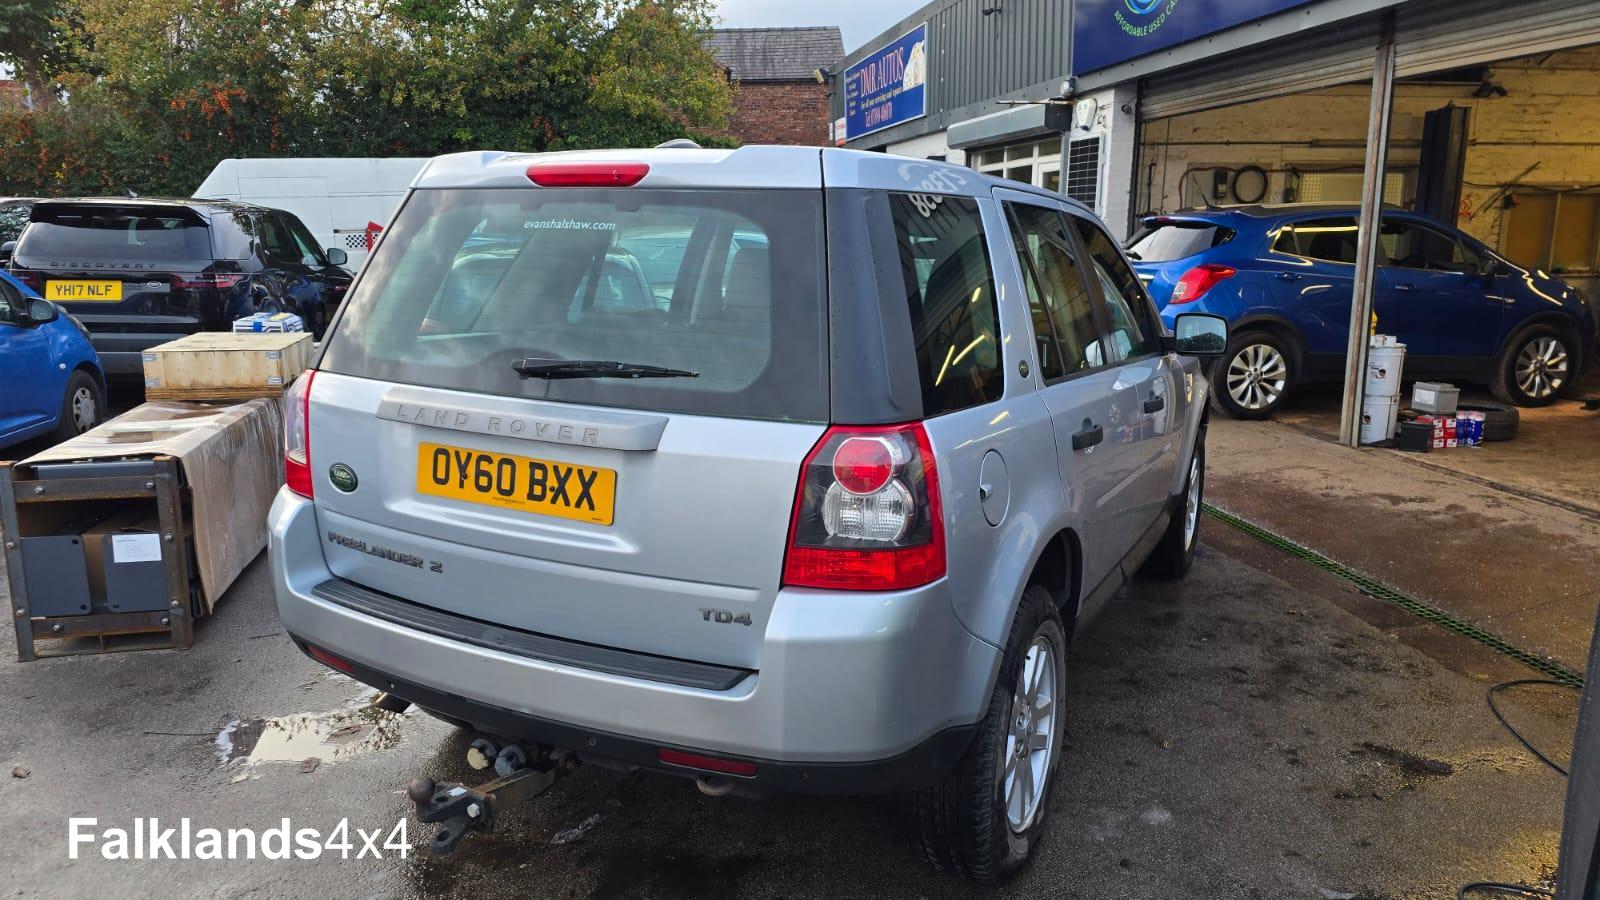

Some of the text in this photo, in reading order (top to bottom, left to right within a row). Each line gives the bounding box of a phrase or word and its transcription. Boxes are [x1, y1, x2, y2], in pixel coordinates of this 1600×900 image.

[1114, 0, 1178, 37] AFFORDABLE USED CA
[877, 47, 903, 89] AUTOS
[523, 218, 616, 231] evanshalshaw.com
[50, 261, 157, 269] DISCOVERY
[55, 284, 113, 296] YH17 NLF
[397, 405, 601, 444] LAND ROVER
[432, 447, 598, 511] OY60 BXX
[328, 530, 444, 574] FREELANDER 2
[698, 607, 753, 627] TD4
